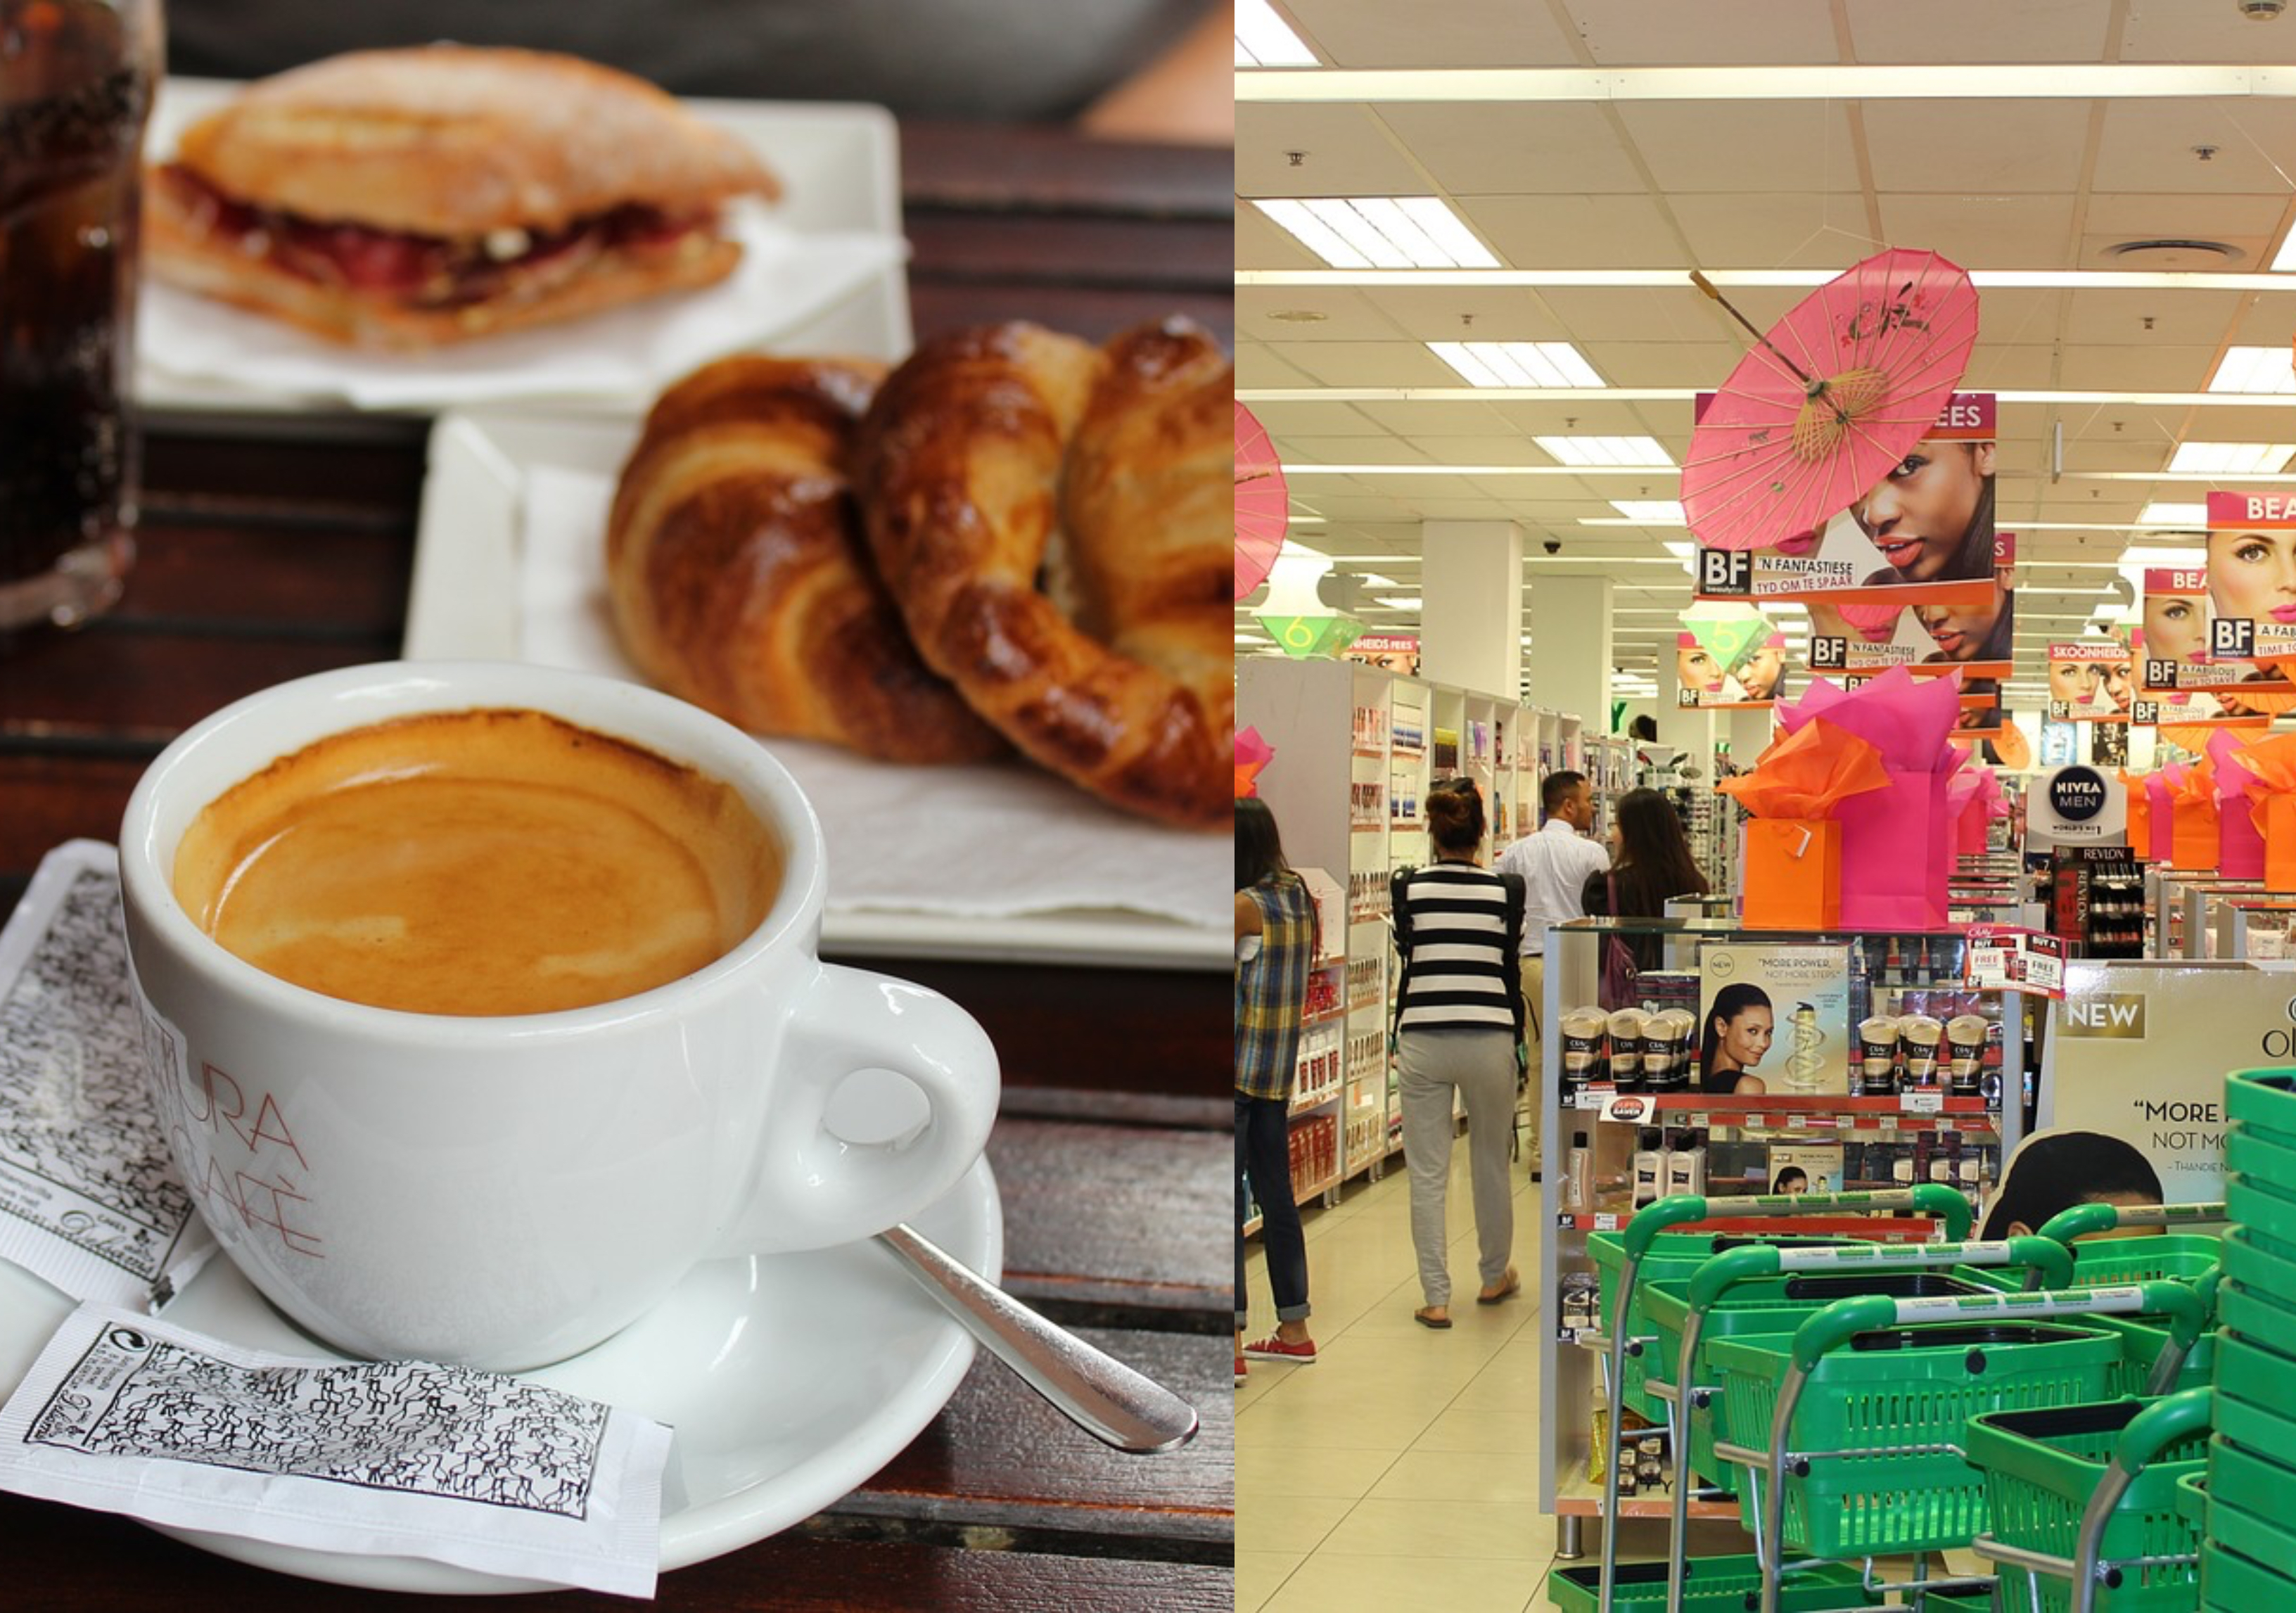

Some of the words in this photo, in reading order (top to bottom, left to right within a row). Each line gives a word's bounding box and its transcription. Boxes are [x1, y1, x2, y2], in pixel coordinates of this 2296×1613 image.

[2247, 497, 2296, 519] BEA
[1705, 552, 1748, 585] BF
[1775, 559, 1853, 575] FANTASTIESE
[1780, 580, 1800, 591] OM
[1803, 578, 1814, 589] TE
[1817, 575, 1853, 587] SPAAR
[1284, 616, 1313, 648] 6
[1713, 620, 1740, 652] 5
[2216, 620, 2251, 649] BF
[2262, 625, 2271, 636] A
[1814, 638, 1844, 661] BF
[2258, 644, 2283, 656] TIME
[2150, 661, 2175, 682] BF
[2190, 665, 2236, 676] FABULOUS
[1682, 690, 1697, 703] BF
[2053, 702, 2069, 716] BF
[2136, 702, 2157, 720] BF
[2056, 782, 2102, 793] NIVEA
[2059, 796, 2096, 808] MEN
[2084, 848, 2125, 860] REVLON
[2077, 869, 2088, 923] REVLON
[2032, 960, 2055, 972] FREE
[2067, 1003, 2138, 1028] NEW
[2152, 1131, 2198, 1150] NOT
